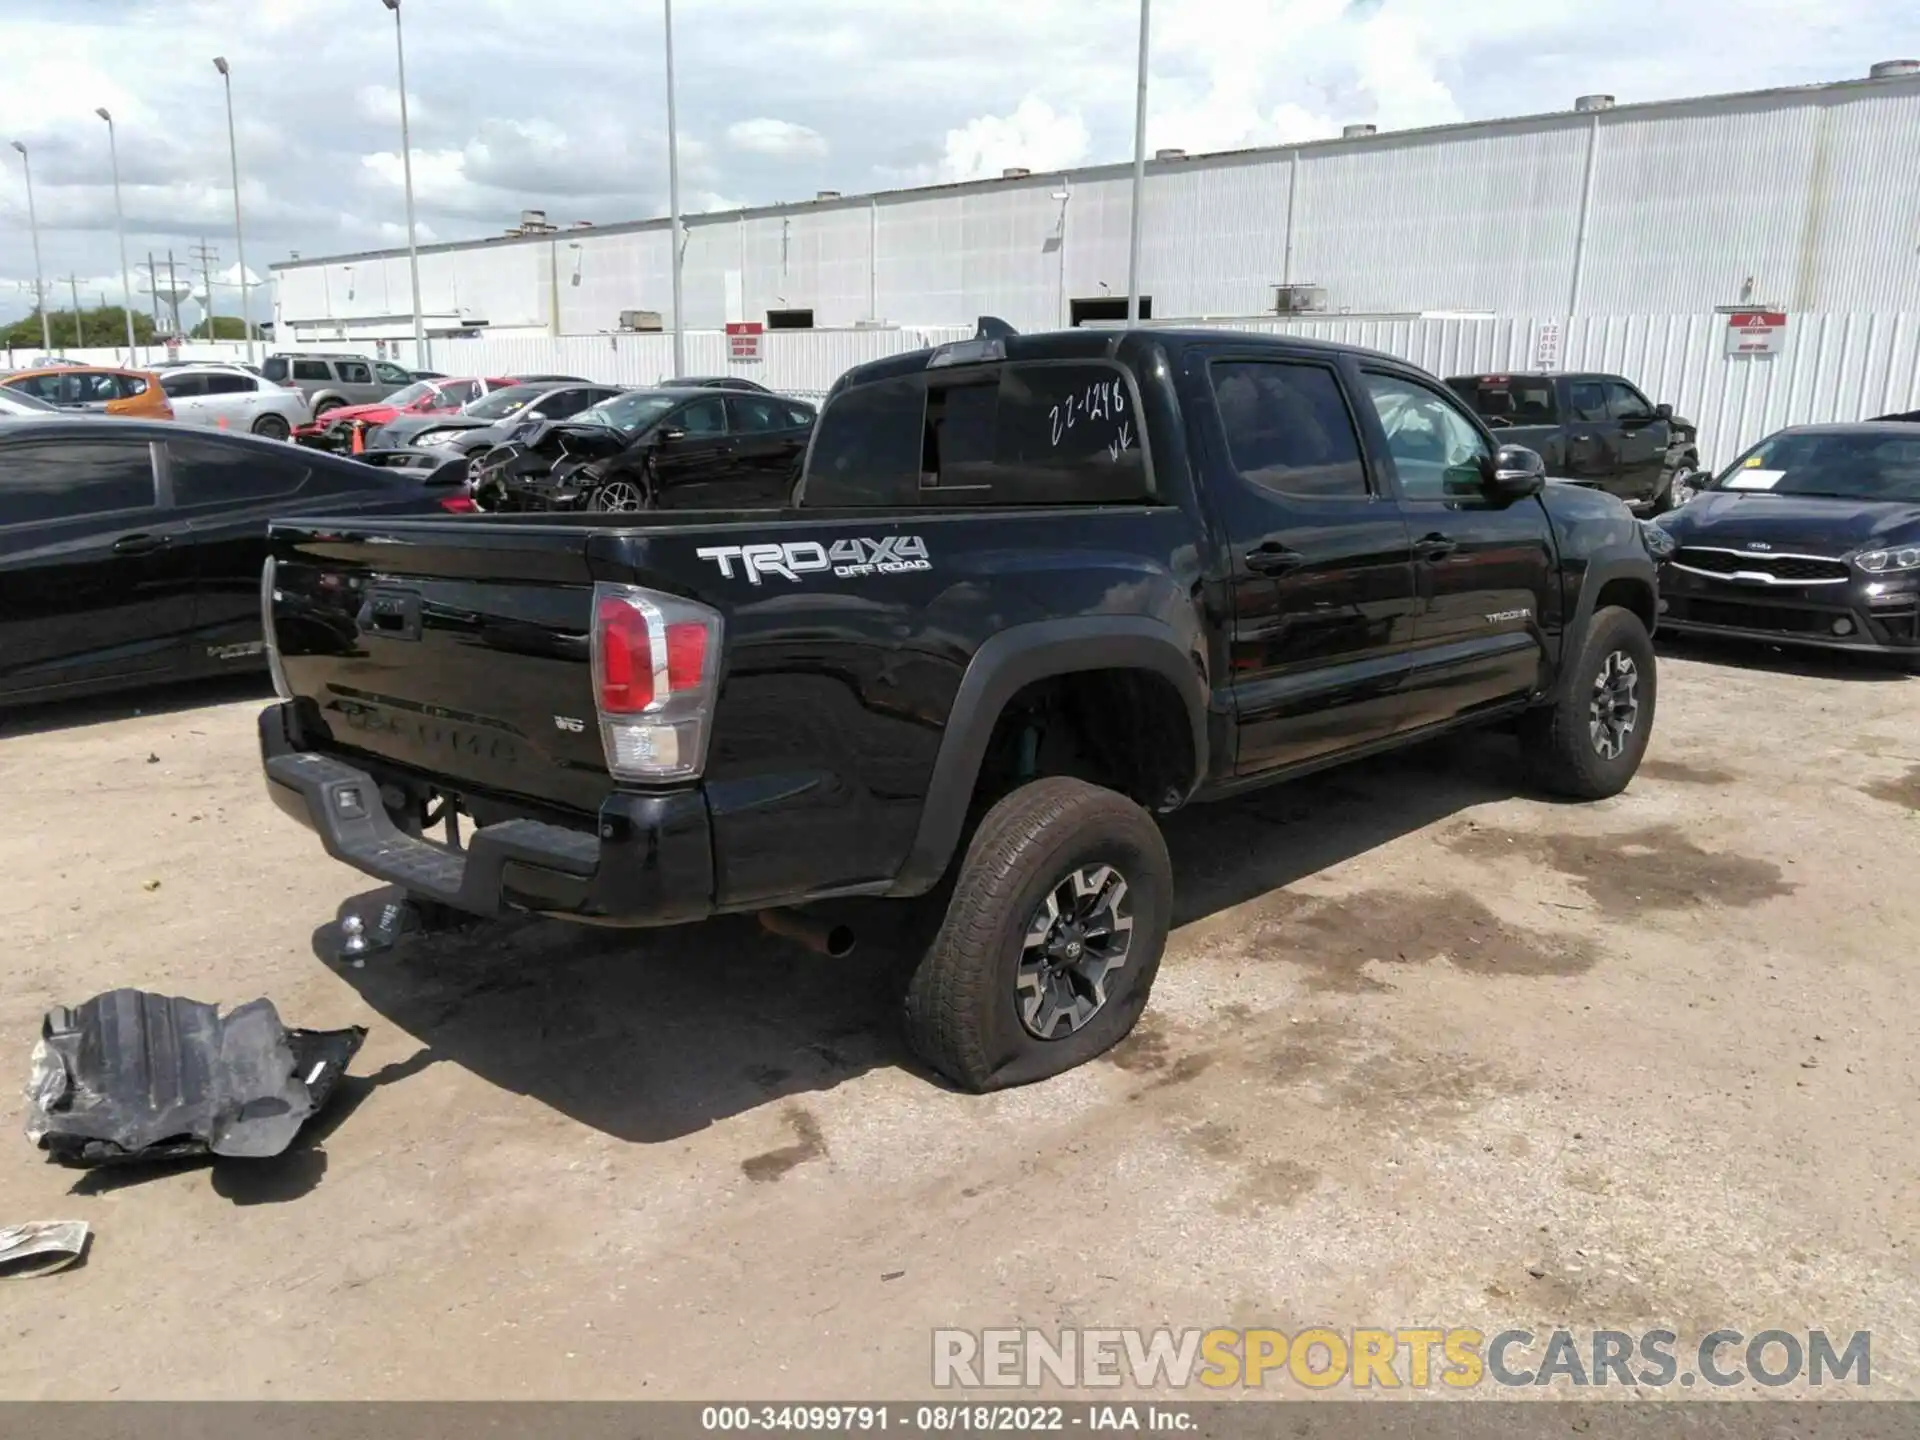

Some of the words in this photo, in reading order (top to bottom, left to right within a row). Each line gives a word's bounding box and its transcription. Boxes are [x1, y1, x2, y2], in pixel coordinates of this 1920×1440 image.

[695, 541, 831, 585] TRD
[833, 563, 874, 579] OFF
[875, 559, 933, 576] ROAD
